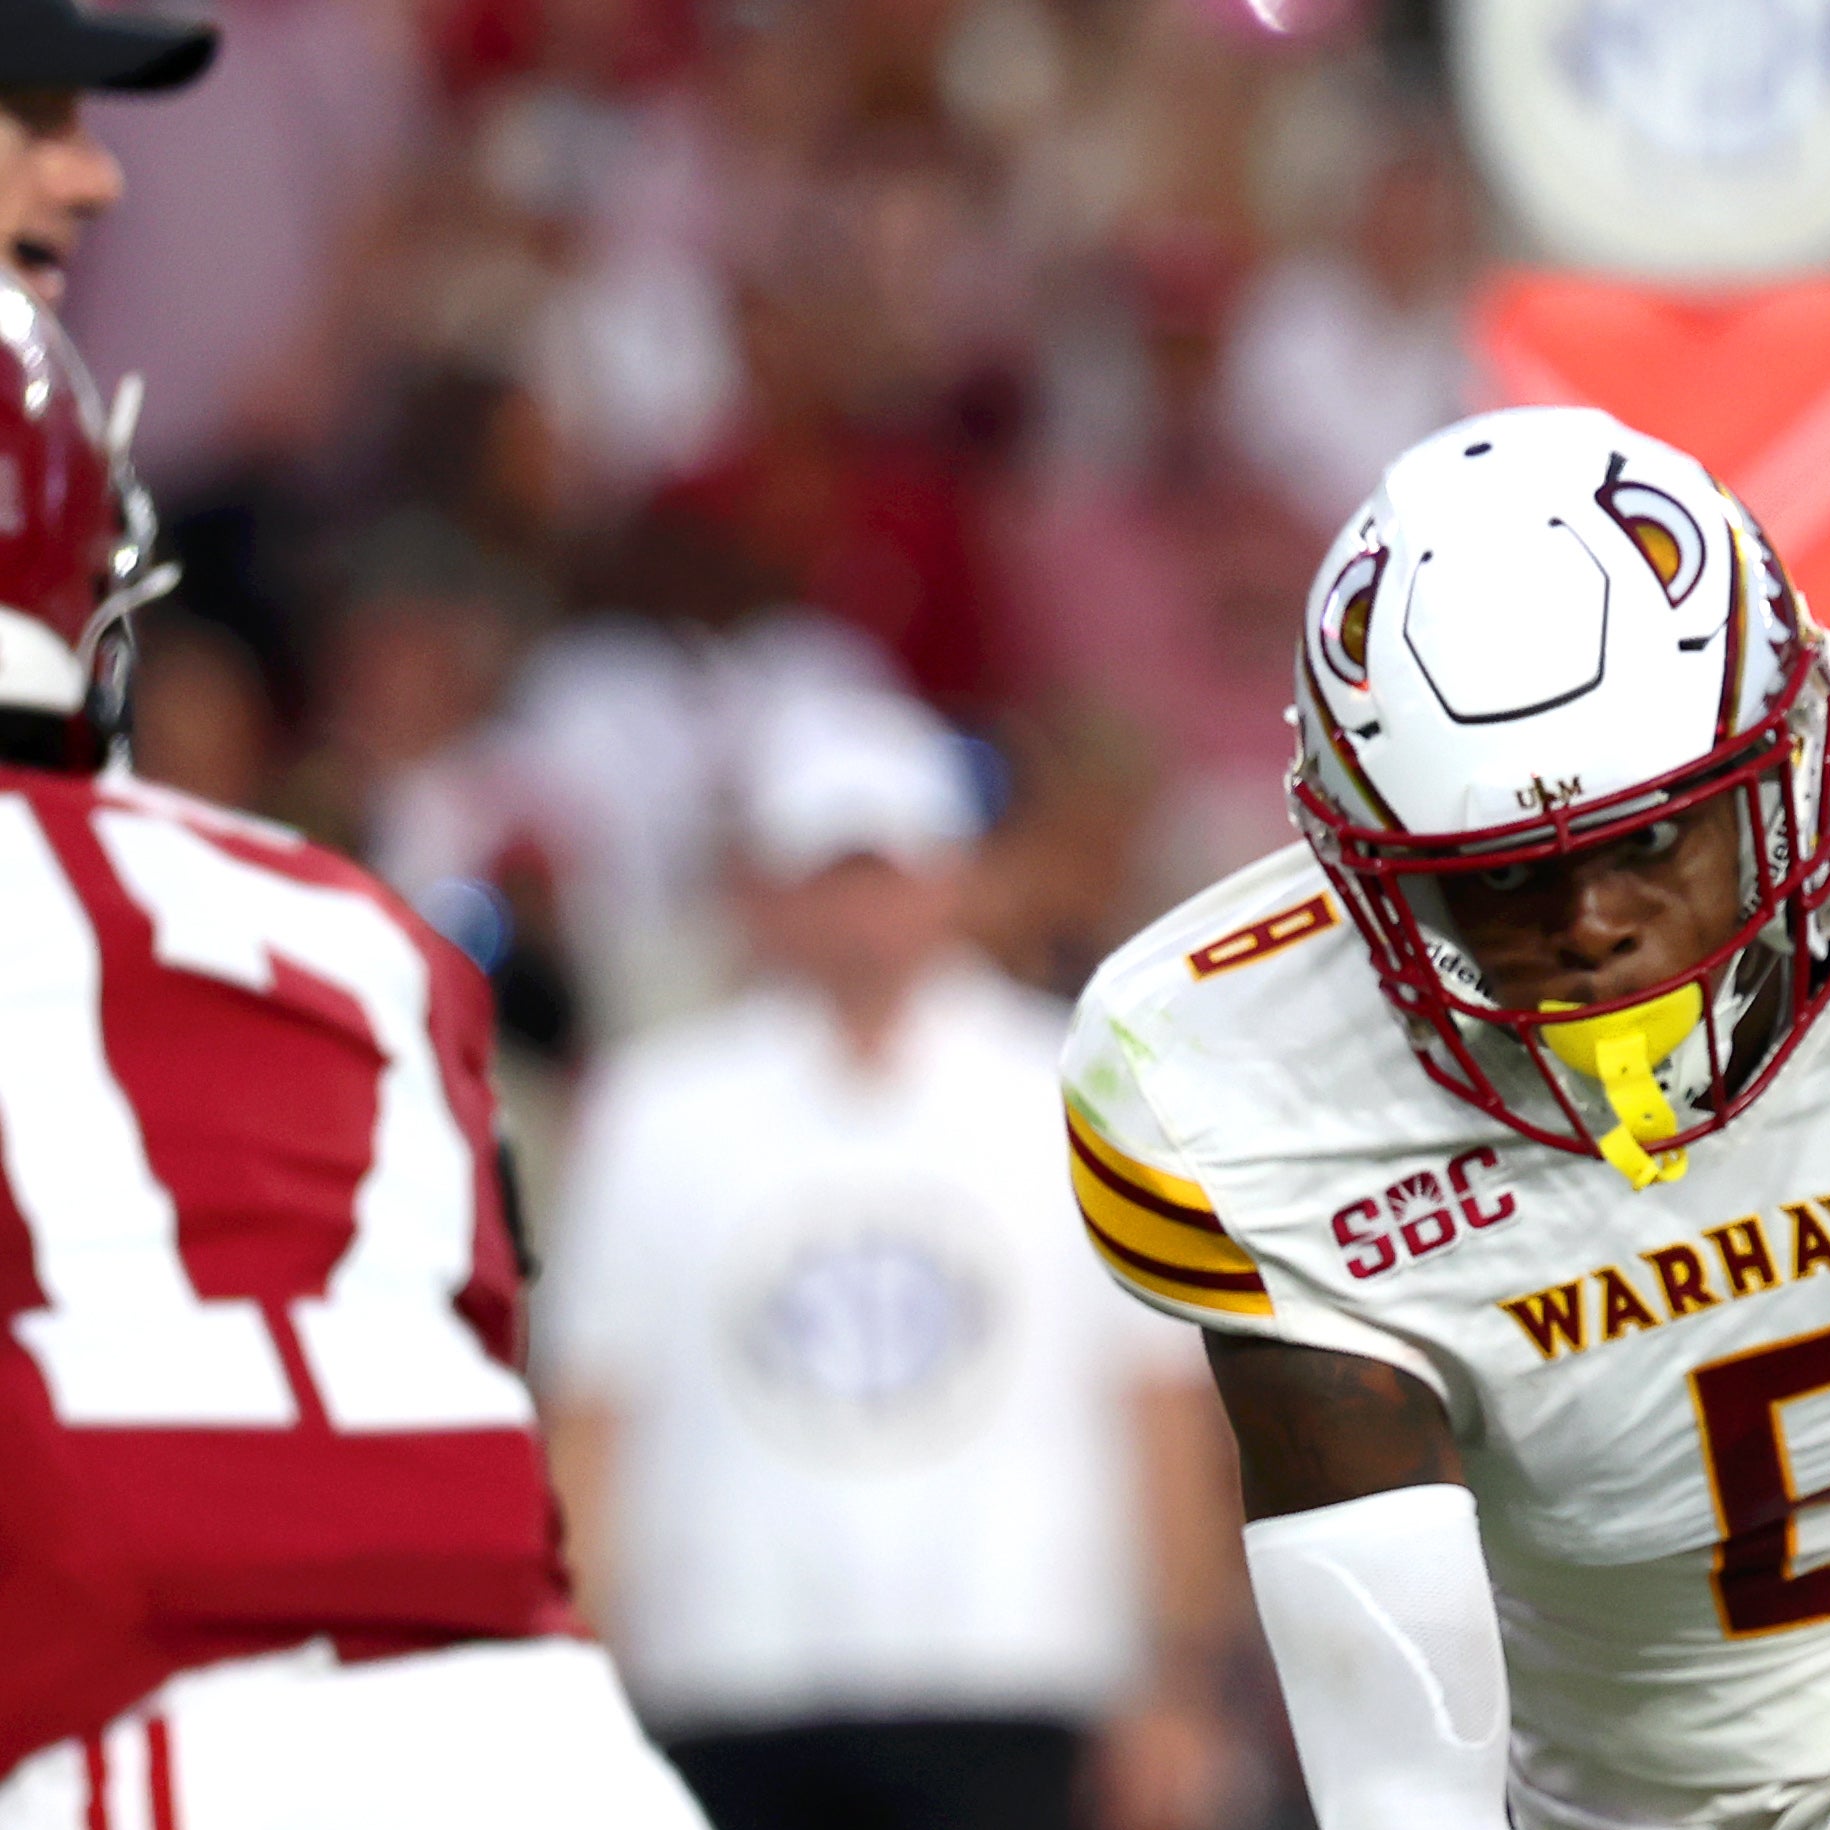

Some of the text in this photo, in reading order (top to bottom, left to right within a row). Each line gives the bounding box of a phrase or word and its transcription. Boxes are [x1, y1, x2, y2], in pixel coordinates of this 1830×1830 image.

[1185, 890, 1343, 980] 8
[0, 788, 540, 1433] 17
[1331, 1146, 1517, 1280] SBC
